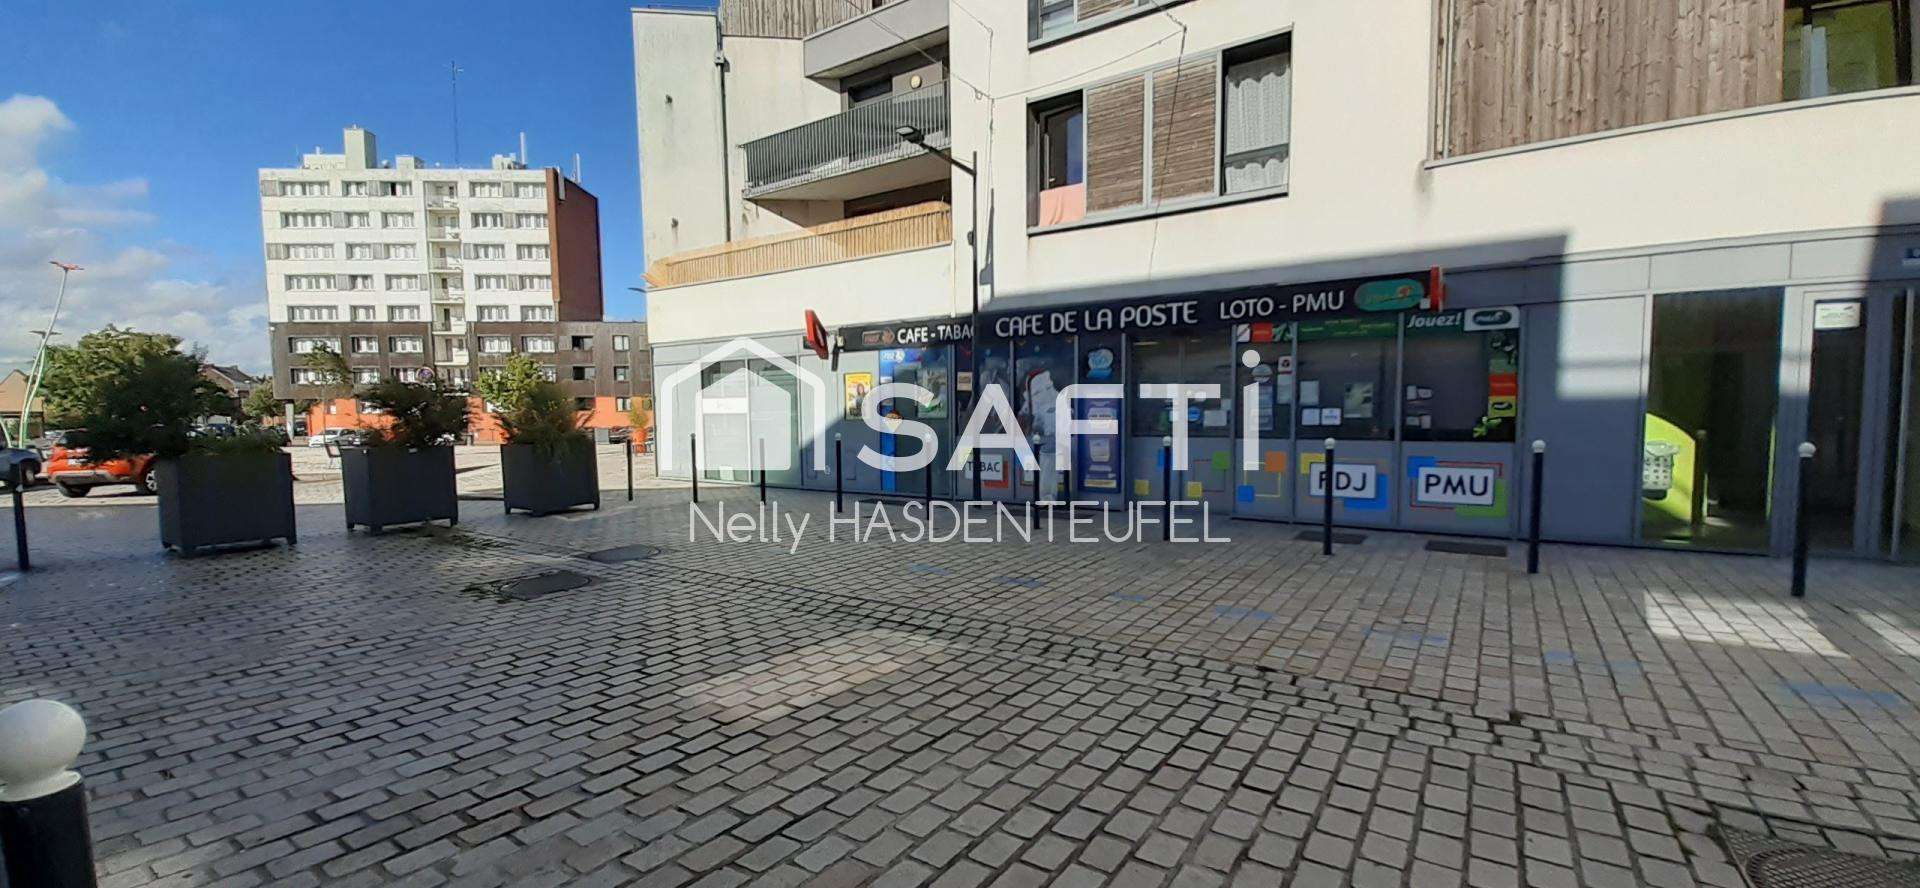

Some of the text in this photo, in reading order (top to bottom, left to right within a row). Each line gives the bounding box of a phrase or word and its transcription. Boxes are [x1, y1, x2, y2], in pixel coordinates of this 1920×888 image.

[1220, 297, 1275, 320] LOTO
[1292, 290, 1345, 313] PMU
[995, 301, 1198, 338] CAFE DE LA POSTE
[1406, 312, 1462, 329] Jouez!
[897, 326, 929, 344] CAFE
[966, 461, 1001, 473] TBAC
[1424, 473, 1489, 497] PMU
